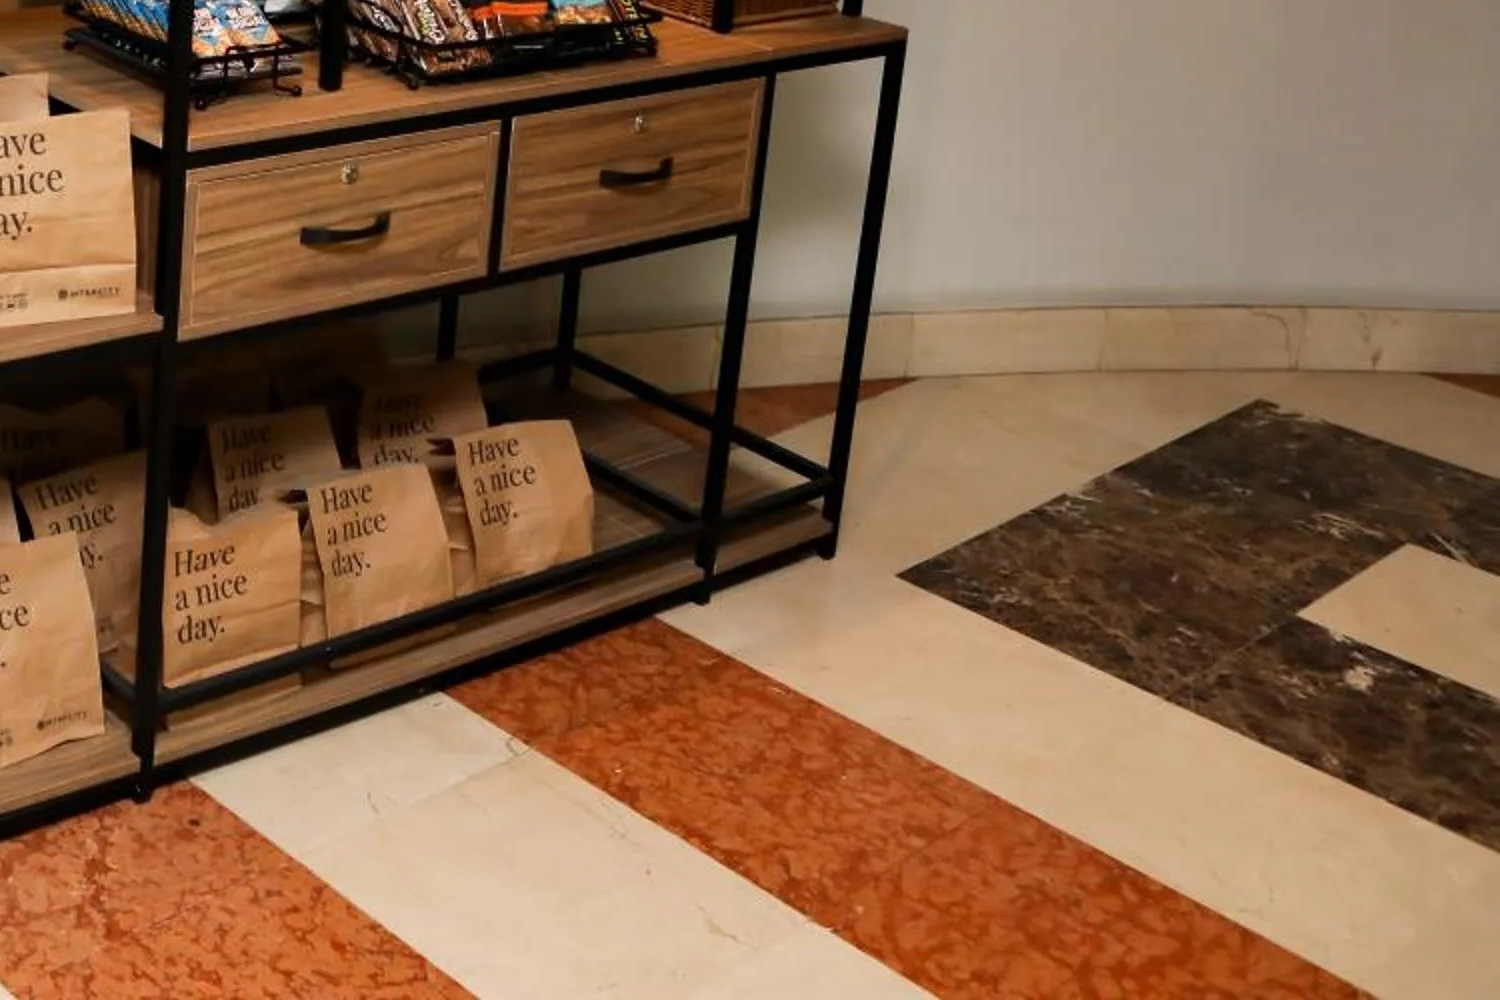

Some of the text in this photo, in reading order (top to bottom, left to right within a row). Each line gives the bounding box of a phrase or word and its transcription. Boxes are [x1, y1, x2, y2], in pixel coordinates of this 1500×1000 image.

[222, 423, 273, 453] Have
[467, 437, 520, 466] Have
[241, 451, 285, 477] nice
[34, 474, 99, 509] Have
[474, 463, 536, 497] a nice
[320, 483, 373, 514] Have
[479, 498, 518, 527] day.
[67, 504, 116, 533] nice
[327, 511, 389, 546] a nice
[174, 545, 235, 578] Have
[331, 549, 371, 577] day.
[175, 573, 248, 611] a nice
[178, 615, 225, 645] day.
